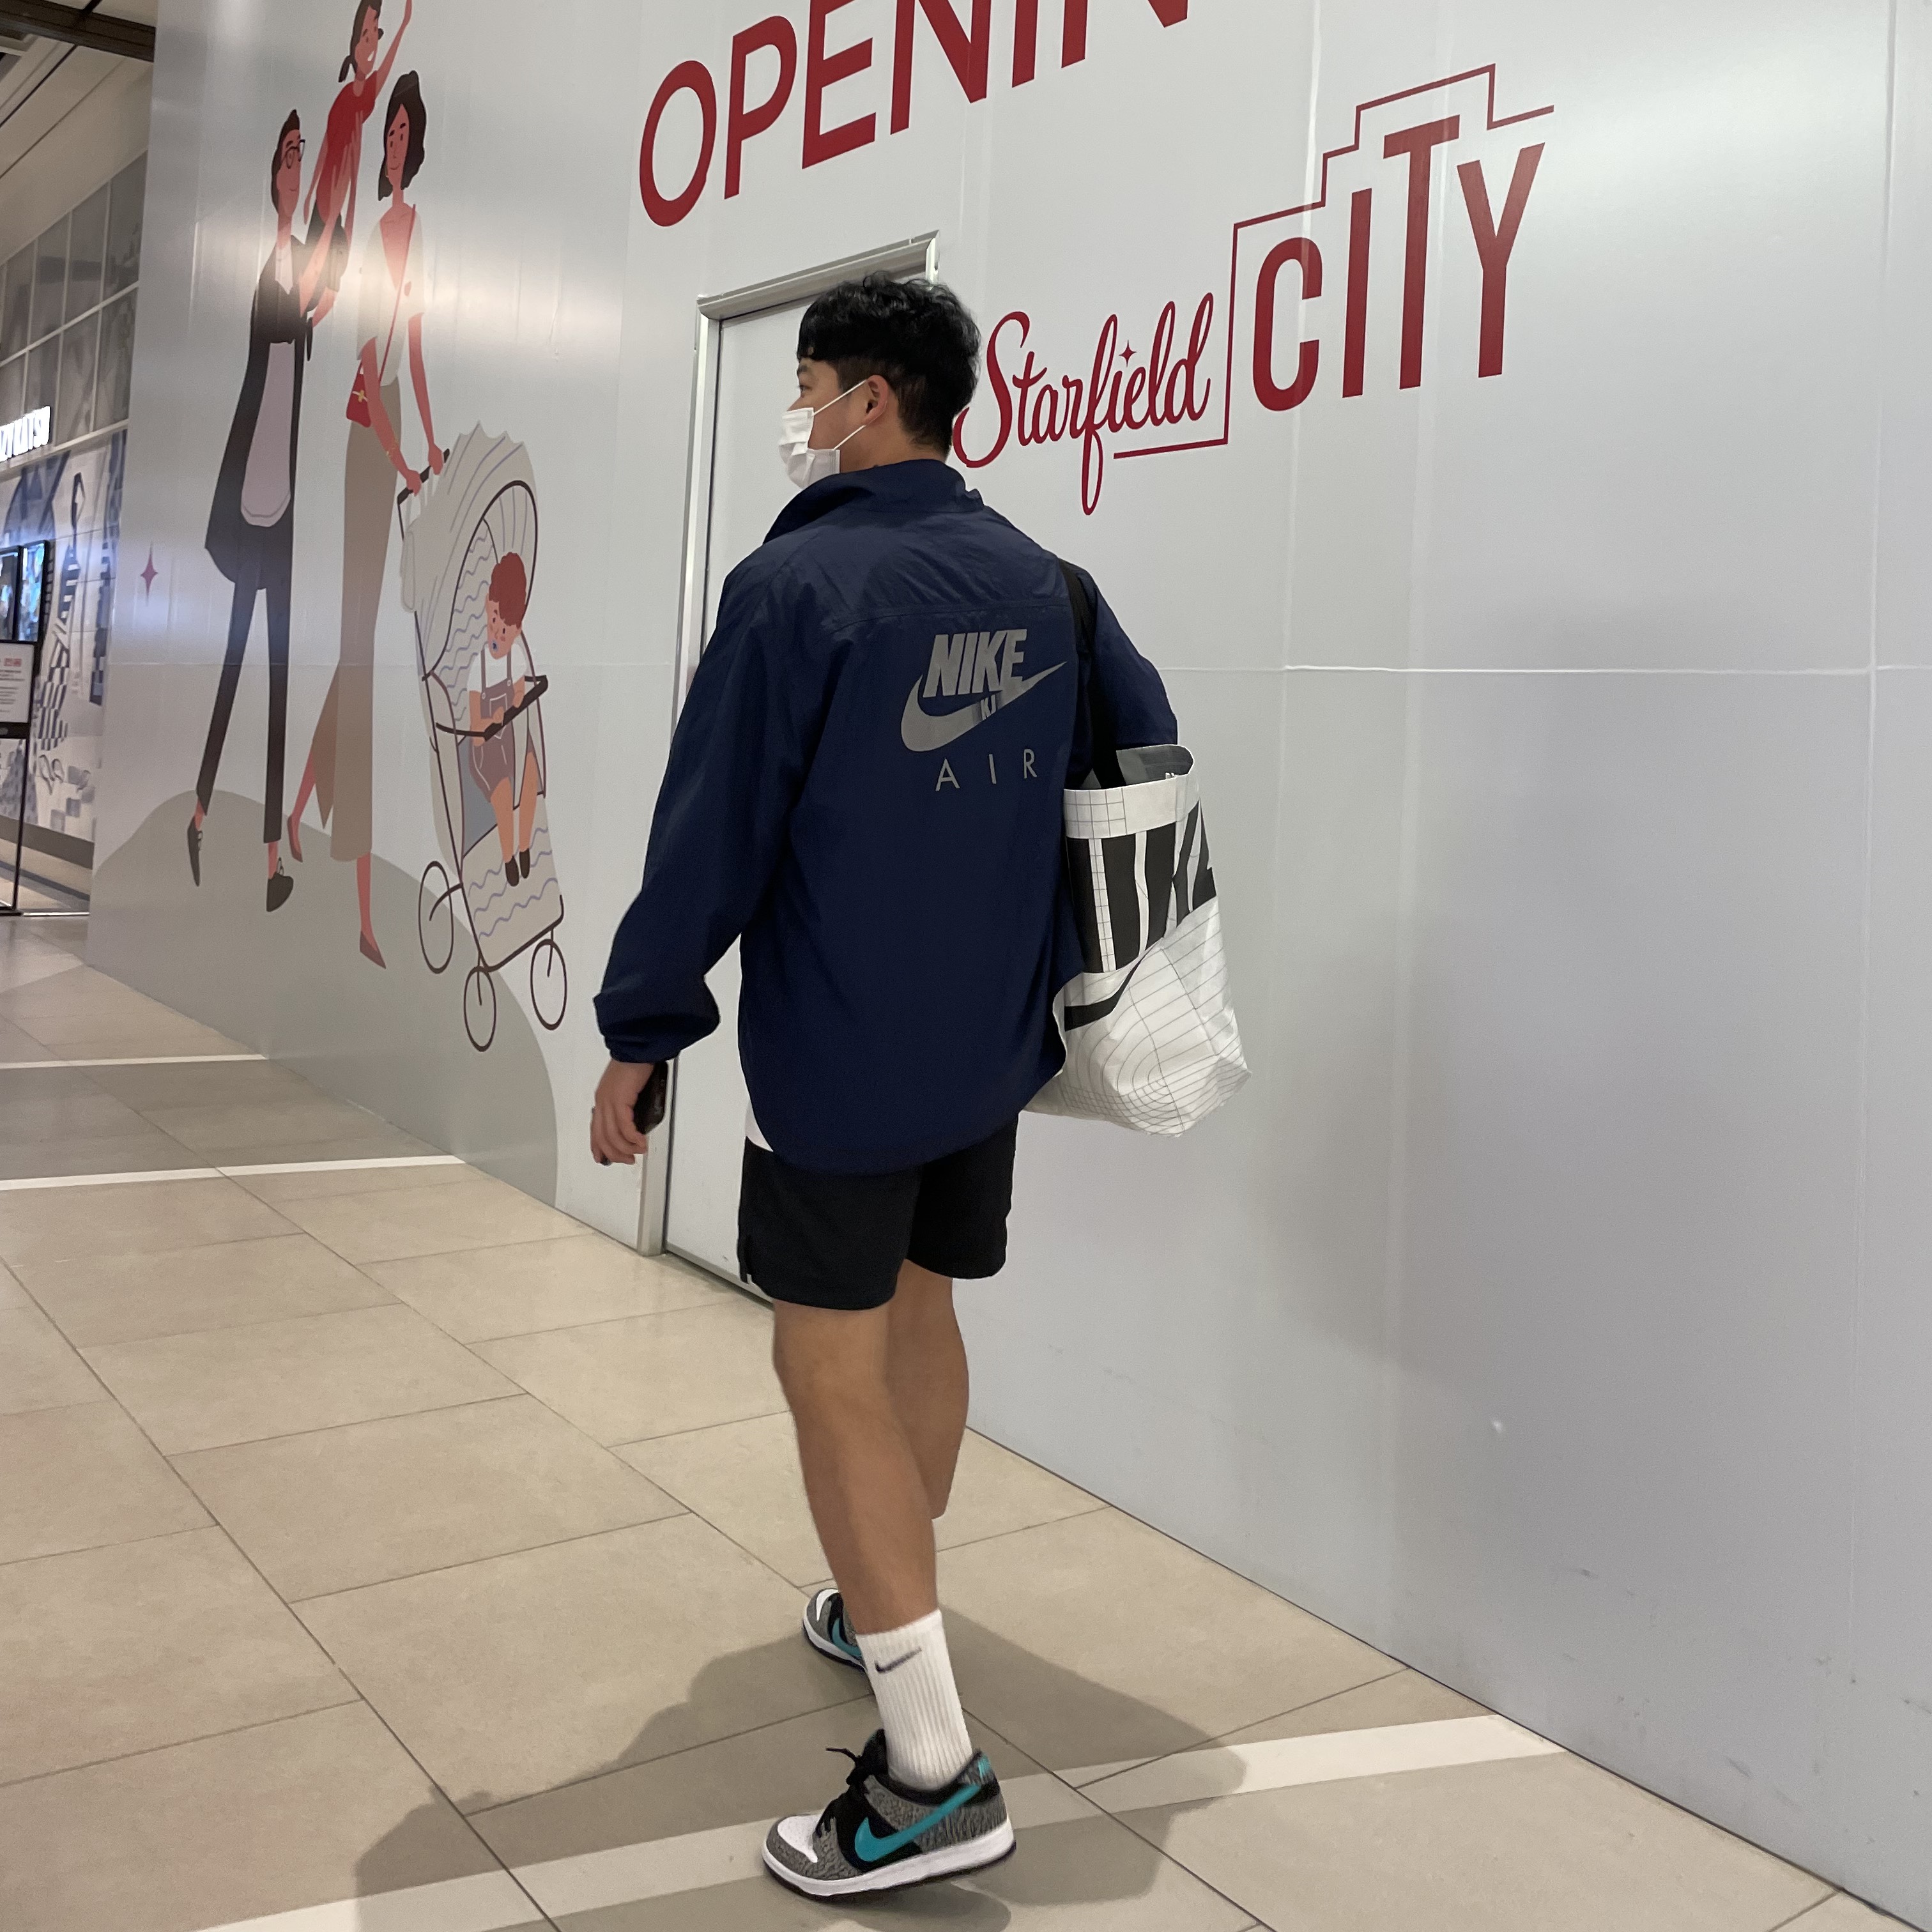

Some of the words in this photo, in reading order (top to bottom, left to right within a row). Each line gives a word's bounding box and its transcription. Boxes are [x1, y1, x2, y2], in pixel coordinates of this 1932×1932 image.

[640, 0, 1188, 227] OPEN
[952, 292, 1214, 515] Starfield
[1252, 114, 1545, 412] CITY
[923, 628, 1027, 698] NIKE
[935, 748, 1038, 792] AIR
